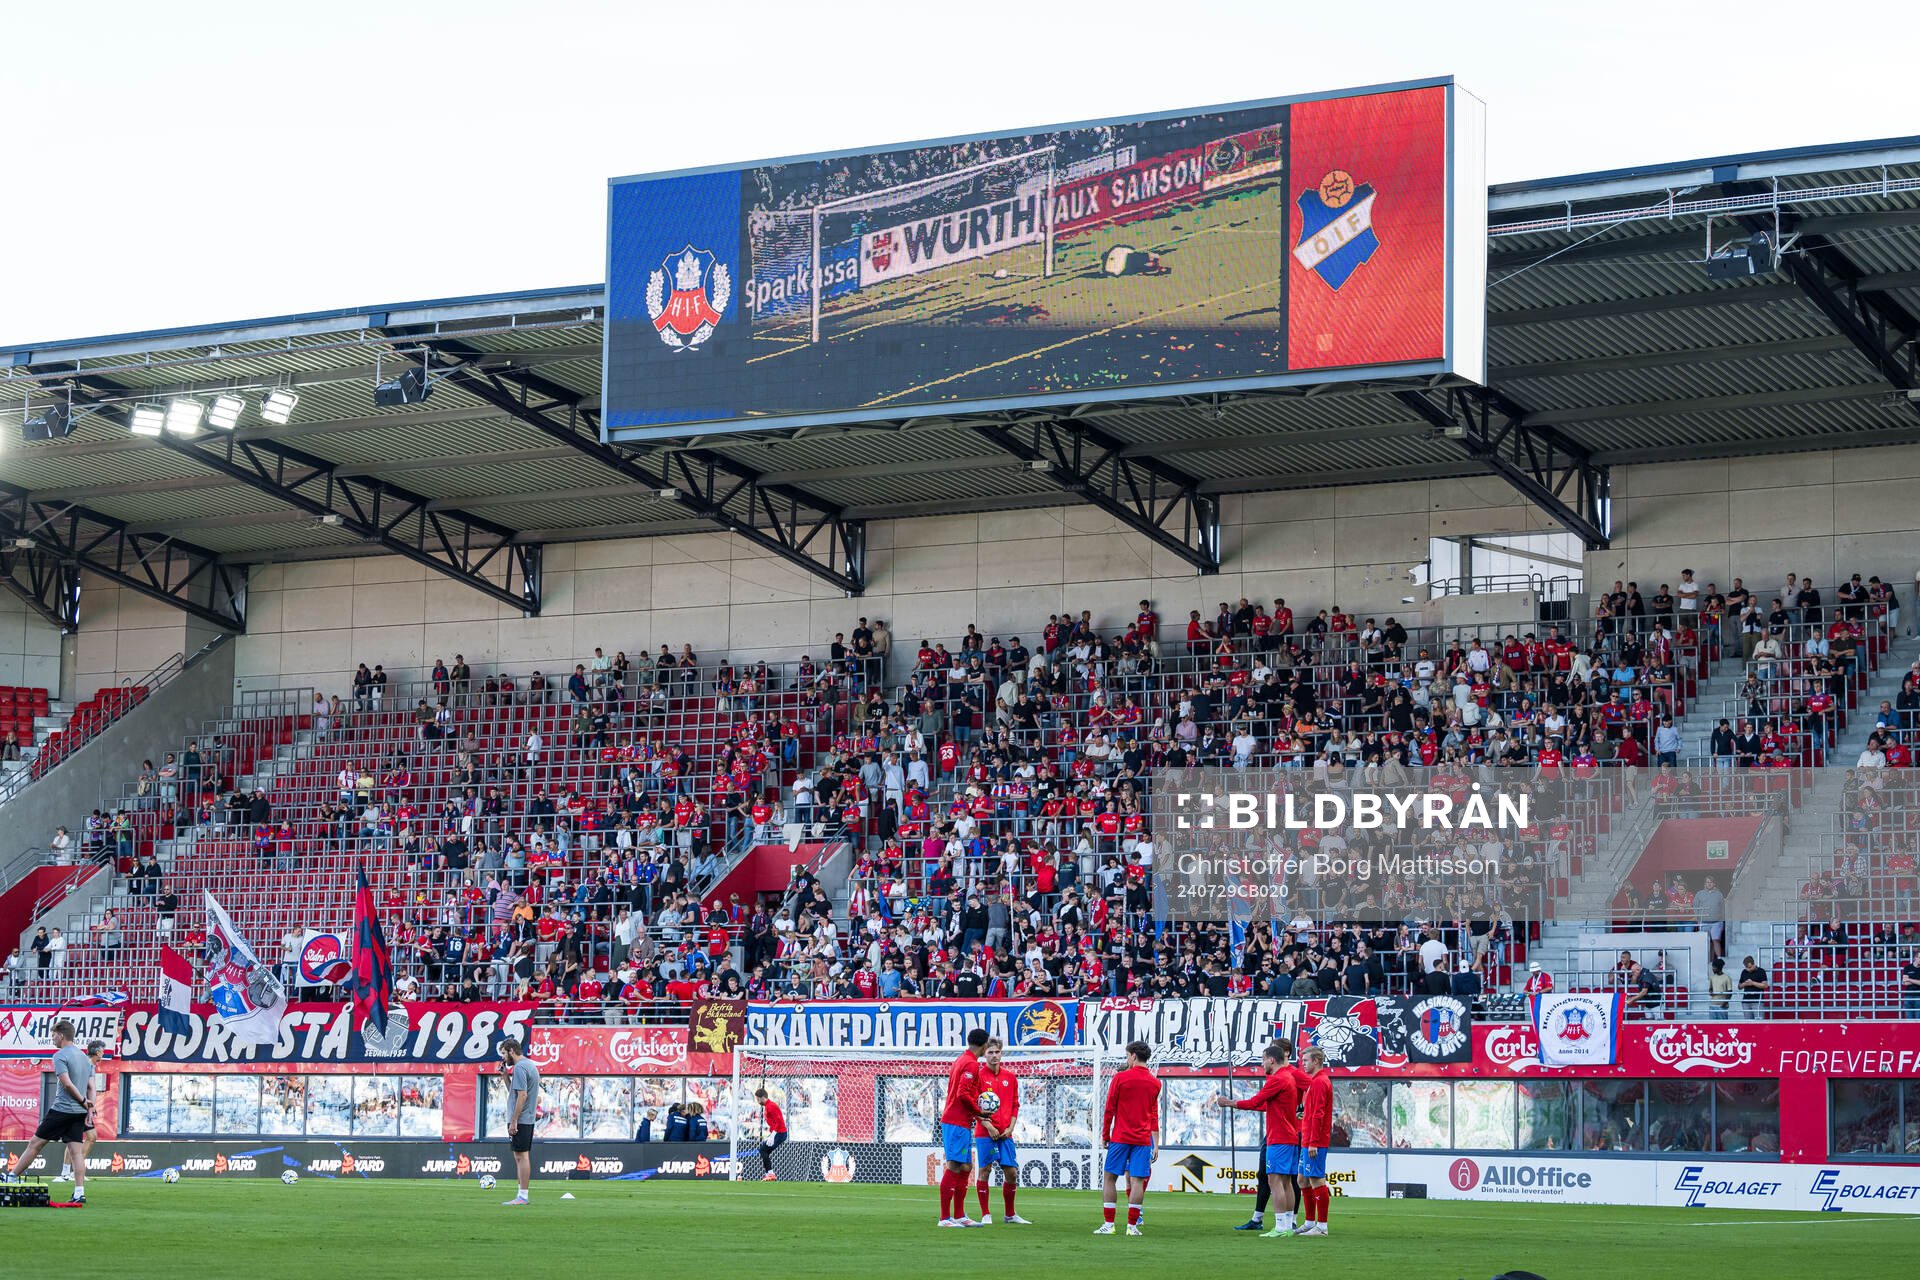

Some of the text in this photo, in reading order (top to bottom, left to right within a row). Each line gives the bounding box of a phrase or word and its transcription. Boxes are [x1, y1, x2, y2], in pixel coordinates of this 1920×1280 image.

[1111, 155, 1203, 207] SAMSON
[904, 190, 1037, 264] WÜRTH
[710, 1003, 733, 1011] Befria
[272, 1001, 355, 1060] STÅ
[412, 1010, 532, 1059] 1985
[748, 1001, 1009, 1047] SKÅNEPÅGARNA
[610, 1031, 688, 1065] Carlsberg
[1485, 1029, 1538, 1064] Carls
[1650, 1028, 1752, 1065] Carlsberg
[181, 1159, 257, 1171] JUMP YARD
[308, 1159, 385, 1172] JUMP YARD
[421, 1160, 502, 1173] JUMP YARD
[539, 1160, 624, 1173] JUMP YARD
[657, 1161, 695, 1174] JUMP
[1482, 1165, 1592, 1189] AllOffice
[1703, 1181, 1781, 1196] BOLAGET
[1840, 1185, 1920, 1200] BOLAGET
